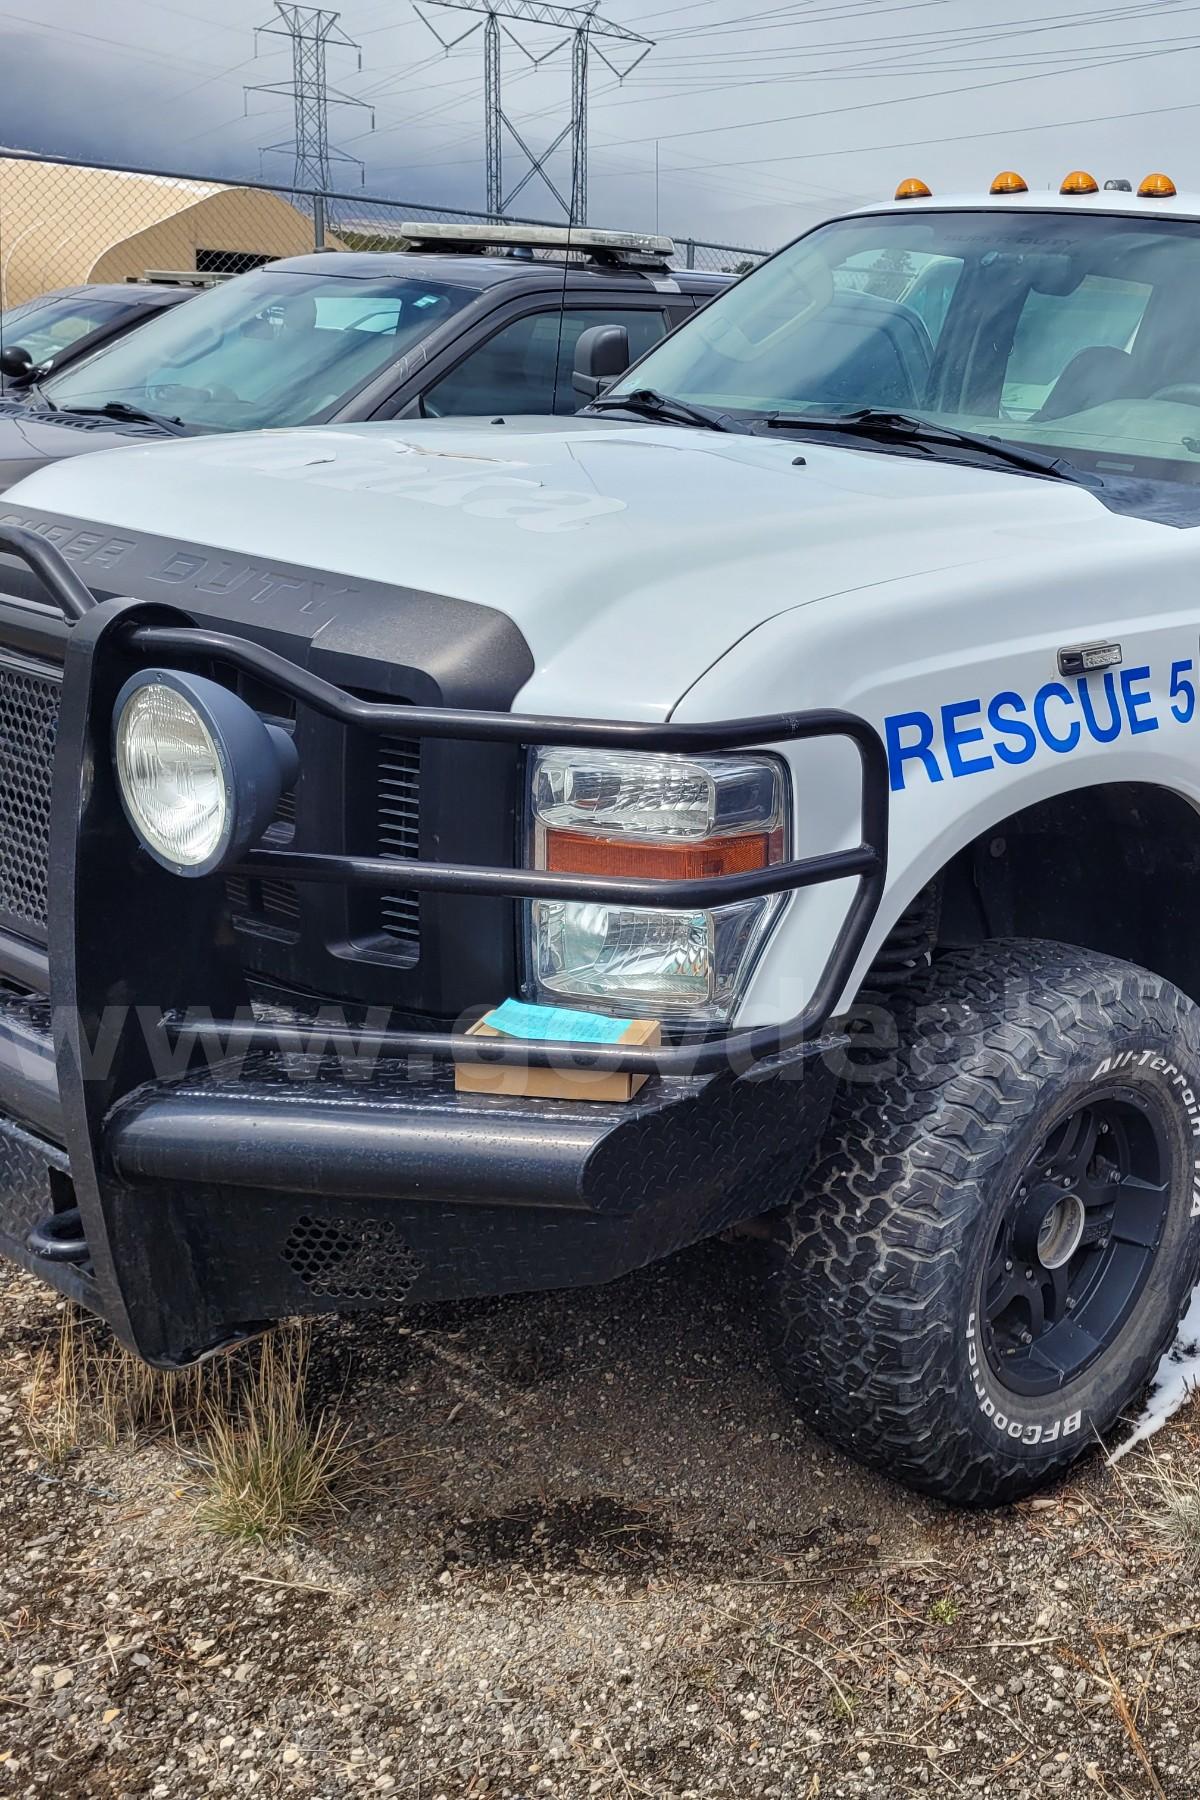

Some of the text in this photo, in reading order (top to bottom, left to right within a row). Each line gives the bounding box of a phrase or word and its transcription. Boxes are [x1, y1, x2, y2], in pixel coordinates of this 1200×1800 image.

[145, 551, 361, 615] DUTY
[884, 659, 1196, 792] RESCUE 5
[965, 1311, 1083, 1446] BFGoodrich
